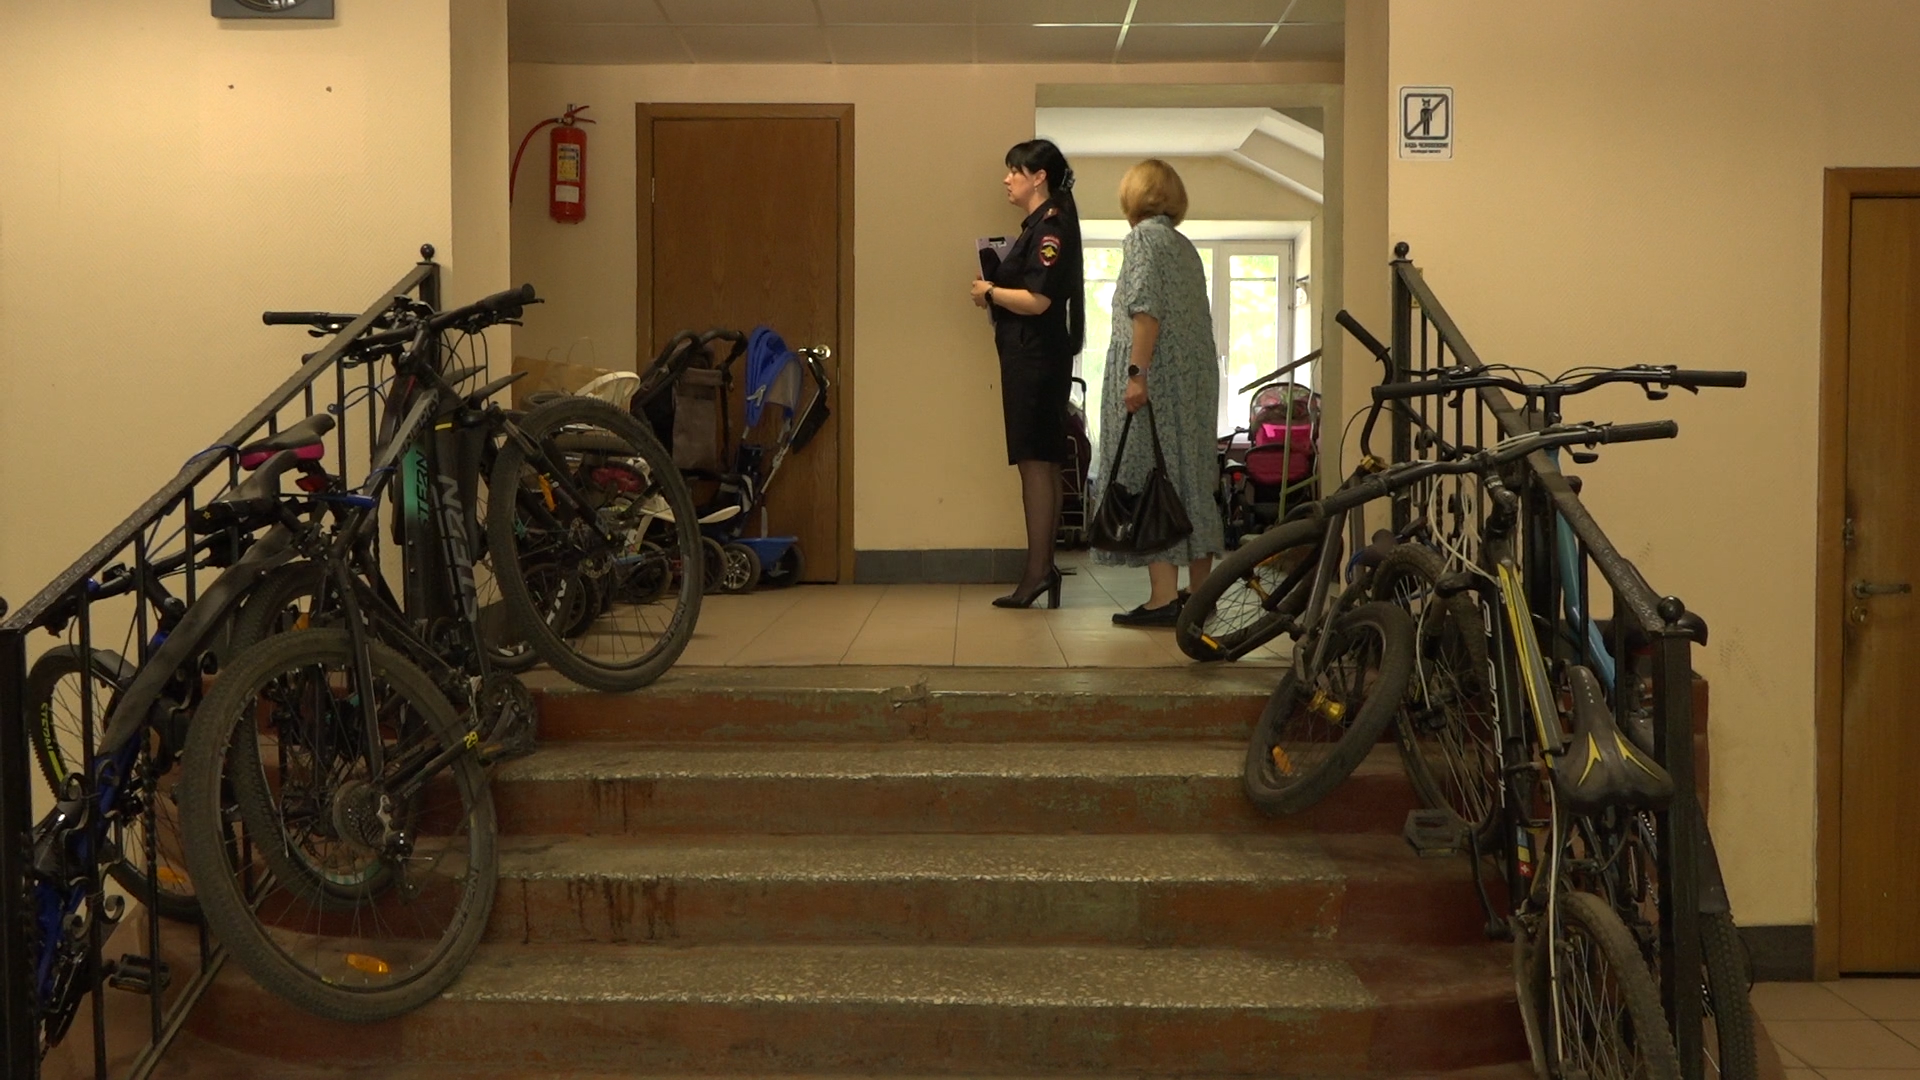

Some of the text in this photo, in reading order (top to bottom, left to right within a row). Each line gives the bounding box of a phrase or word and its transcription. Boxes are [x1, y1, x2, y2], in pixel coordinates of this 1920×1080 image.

[416, 450, 430, 528] STERN
[437, 475, 478, 623] STERN
[463, 730, 479, 749] 29
